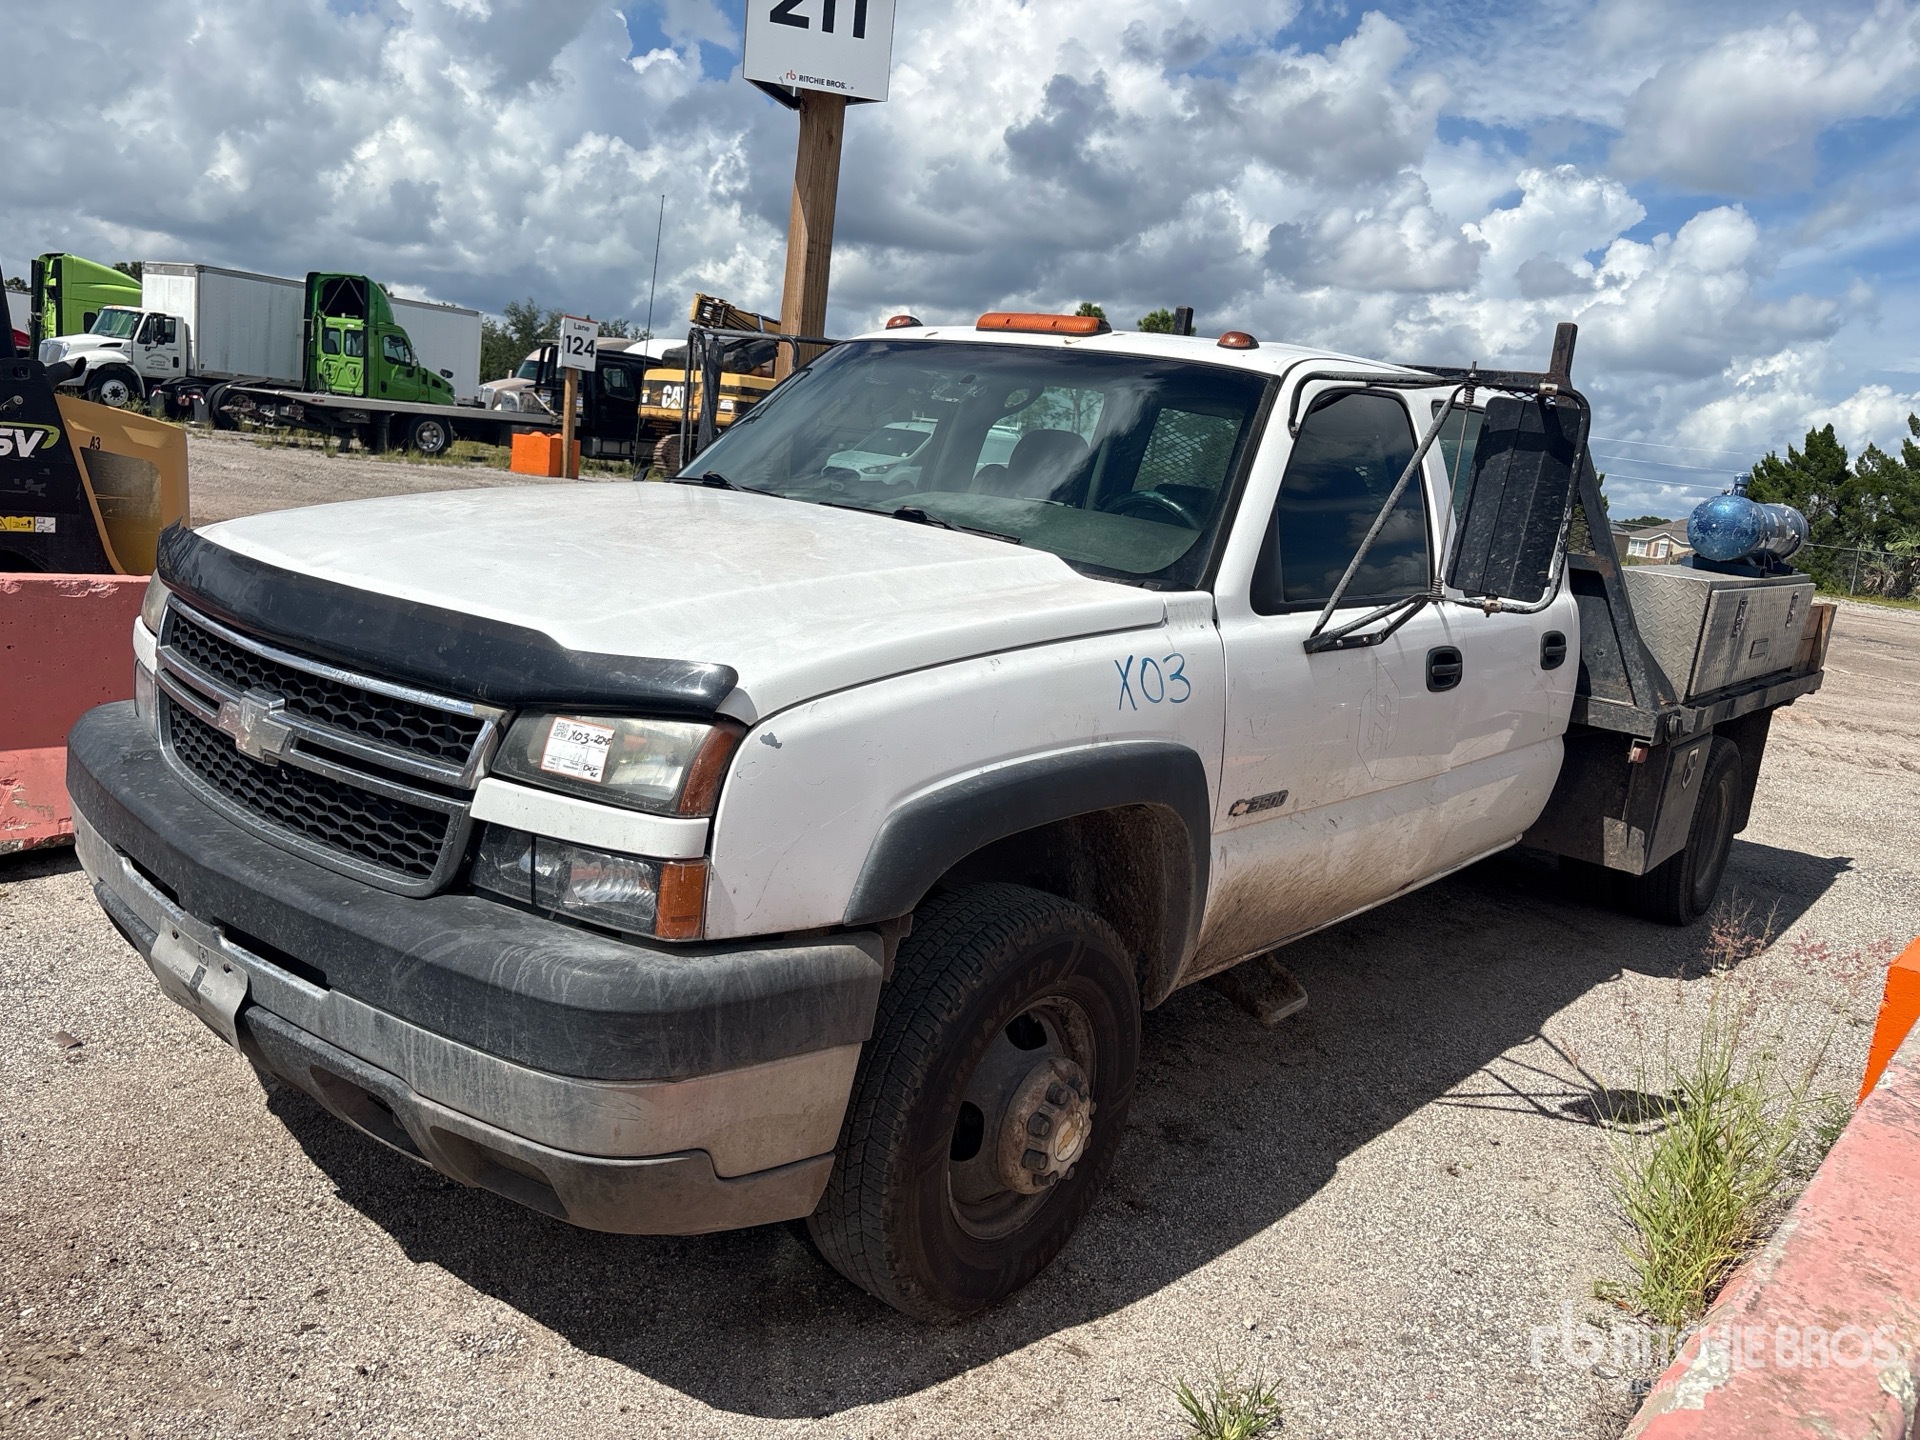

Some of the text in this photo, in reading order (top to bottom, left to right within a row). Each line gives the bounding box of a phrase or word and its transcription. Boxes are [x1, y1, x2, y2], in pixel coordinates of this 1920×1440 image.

[798, 74, 825, 86] RITCHIE
[573, 322, 591, 332] Lane
[565, 335, 596, 358] 124
[89, 435, 101, 451] A3
[1113, 652, 1192, 711] X03
[1248, 789, 1289, 813] 3500
